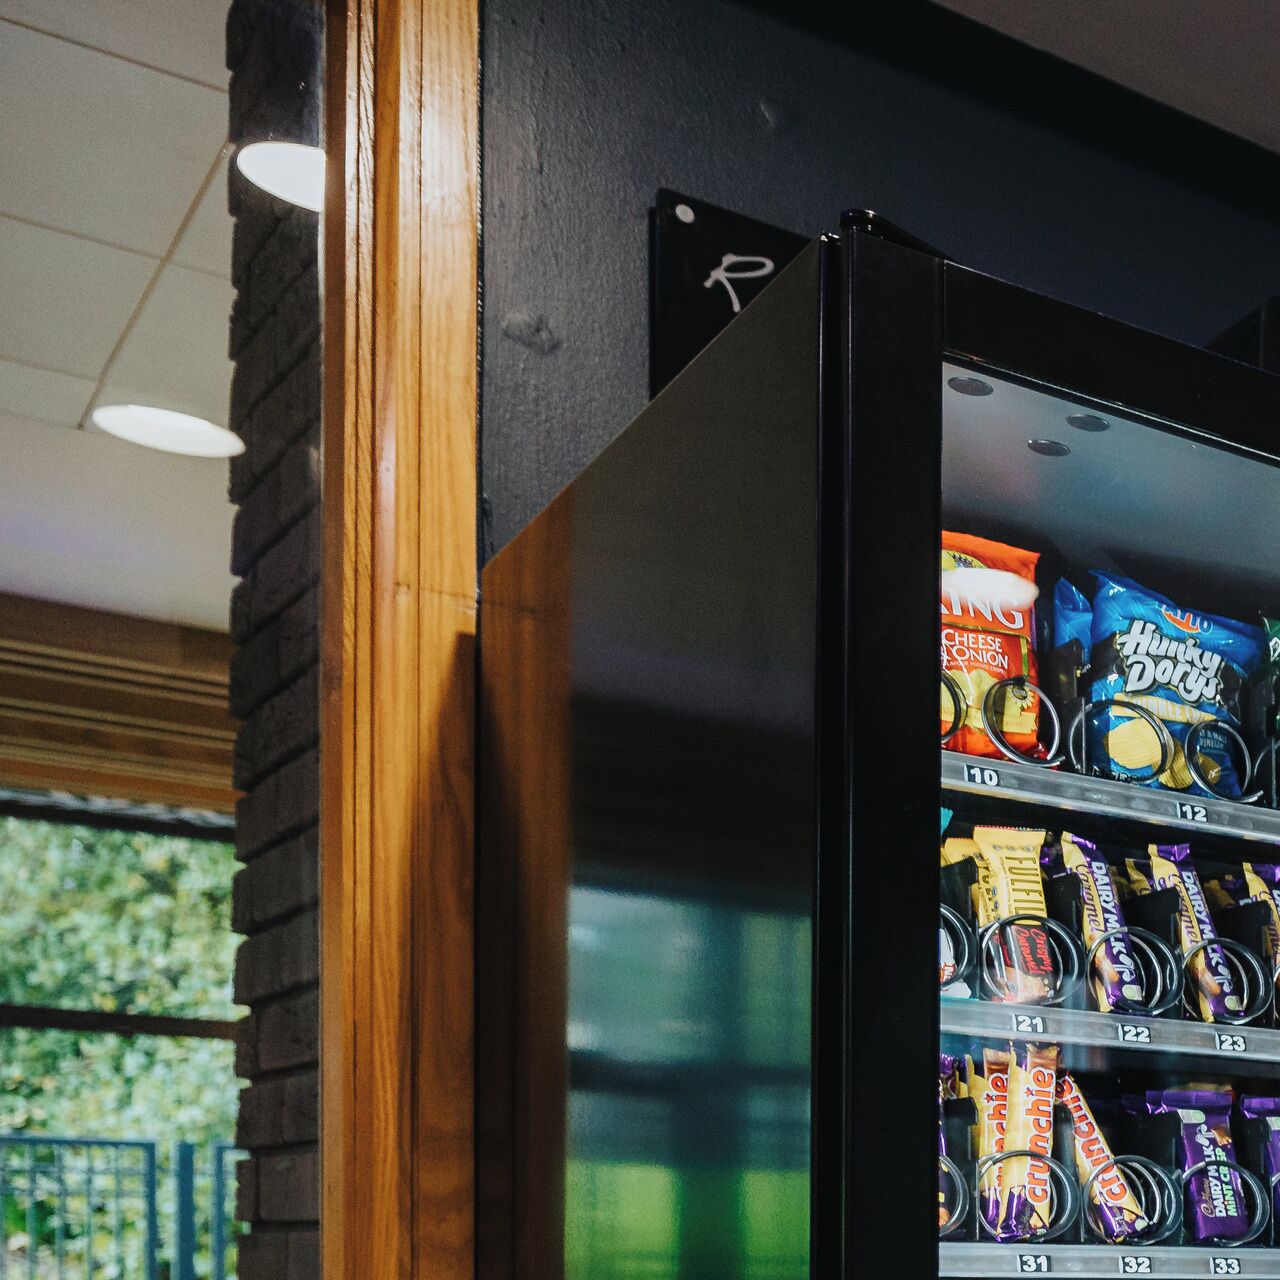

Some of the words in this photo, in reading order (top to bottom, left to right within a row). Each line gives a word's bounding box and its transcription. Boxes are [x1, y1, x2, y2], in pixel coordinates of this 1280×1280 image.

[941, 629, 1003, 653] CHEESE
[1117, 620, 1222, 678] Hunky
[951, 645, 1009, 670] ONION
[1126, 655, 1219, 703] Dorys
[970, 768, 999, 786] 10
[1182, 806, 1208, 822] 12
[1091, 861, 1116, 913] DAIRY
[1181, 871, 1207, 926] DAIRY
[1017, 1016, 1044, 1033] 21
[1124, 1026, 1150, 1043] 22
[1220, 1035, 1246, 1051] 23
[1025, 1067, 1055, 1204] crunchie
[1209, 1176, 1227, 1218] DAIRY
[1021, 1256, 1049, 1272] 31
[1124, 1257, 1151, 1273] 32
[1214, 1258, 1240, 1274] 33
